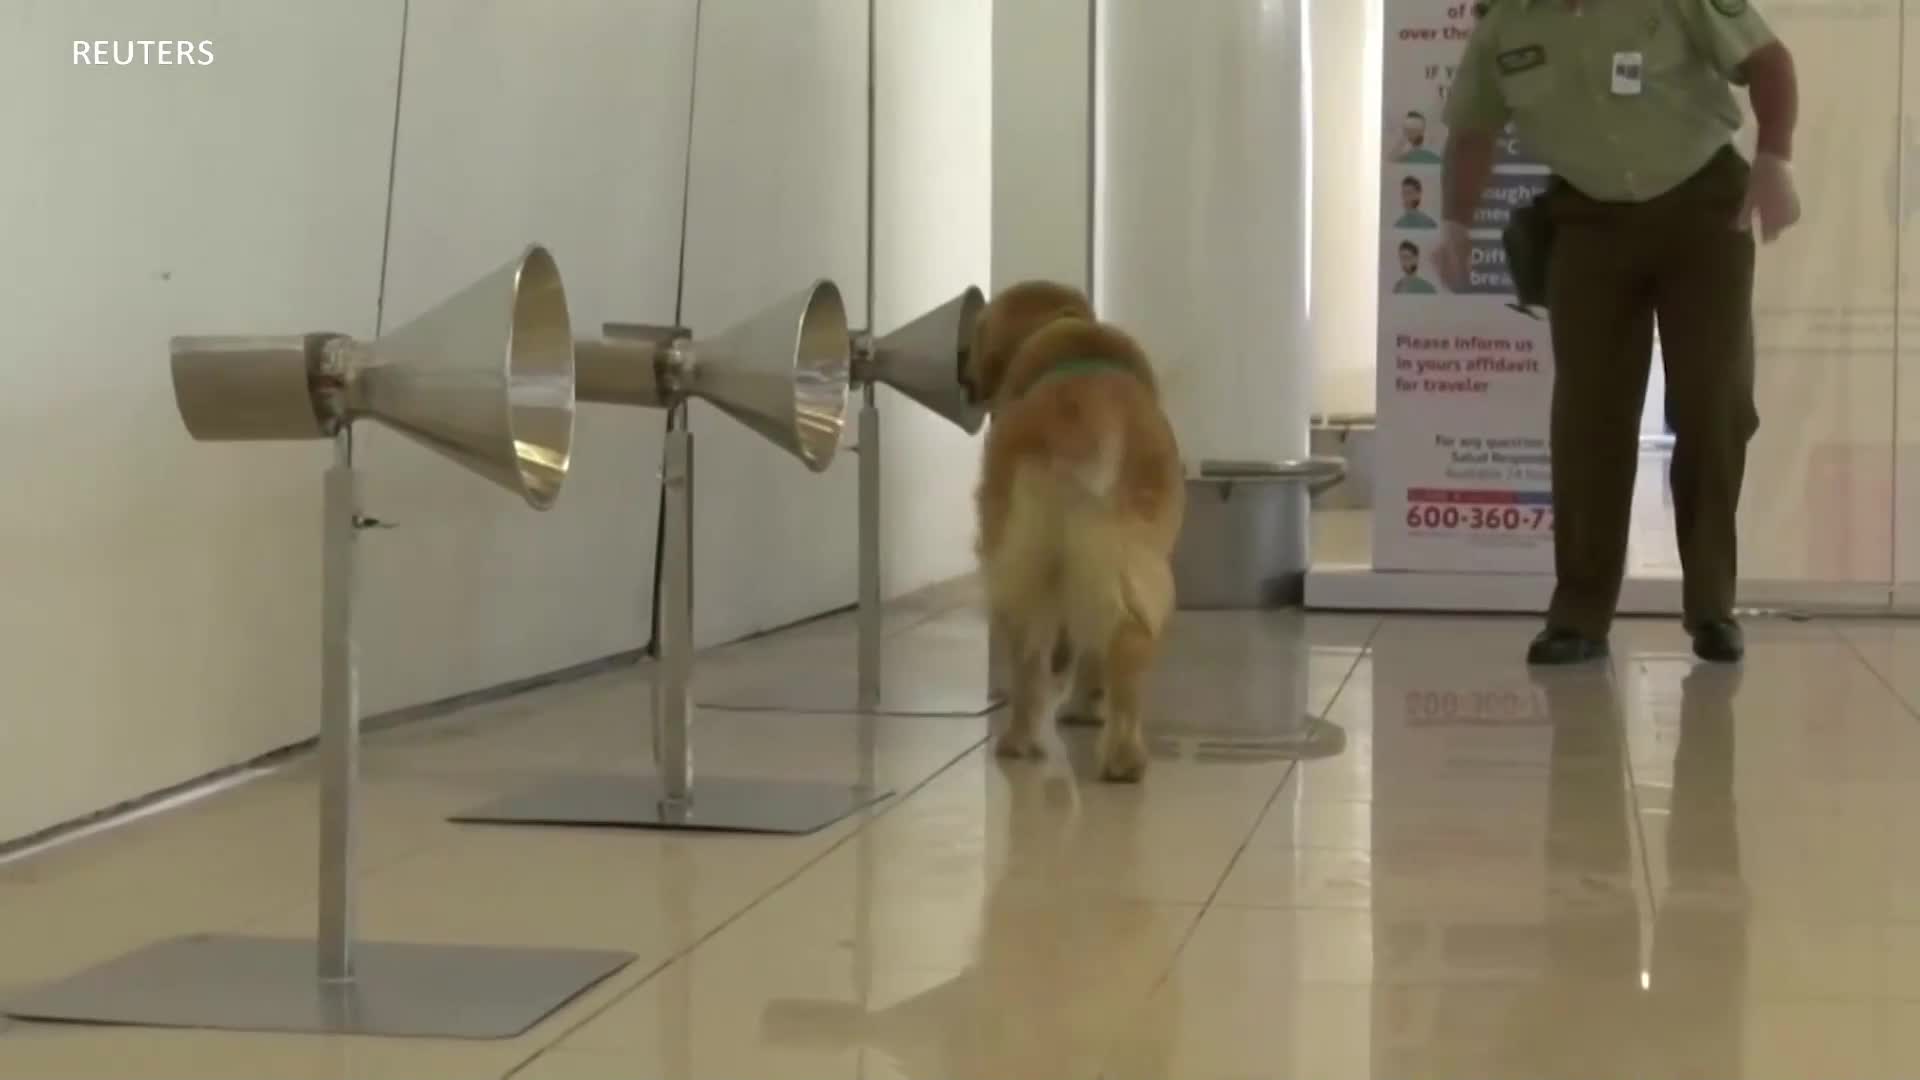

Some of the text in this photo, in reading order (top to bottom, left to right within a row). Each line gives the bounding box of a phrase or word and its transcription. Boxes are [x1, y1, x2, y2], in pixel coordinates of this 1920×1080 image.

[1447, 3, 1465, 19] of
[1399, 28, 1437, 41] over
[1396, 335, 1533, 351] Please inform us
[1396, 357, 1539, 374] in yours affidavit
[1395, 377, 1489, 393] for traveler
